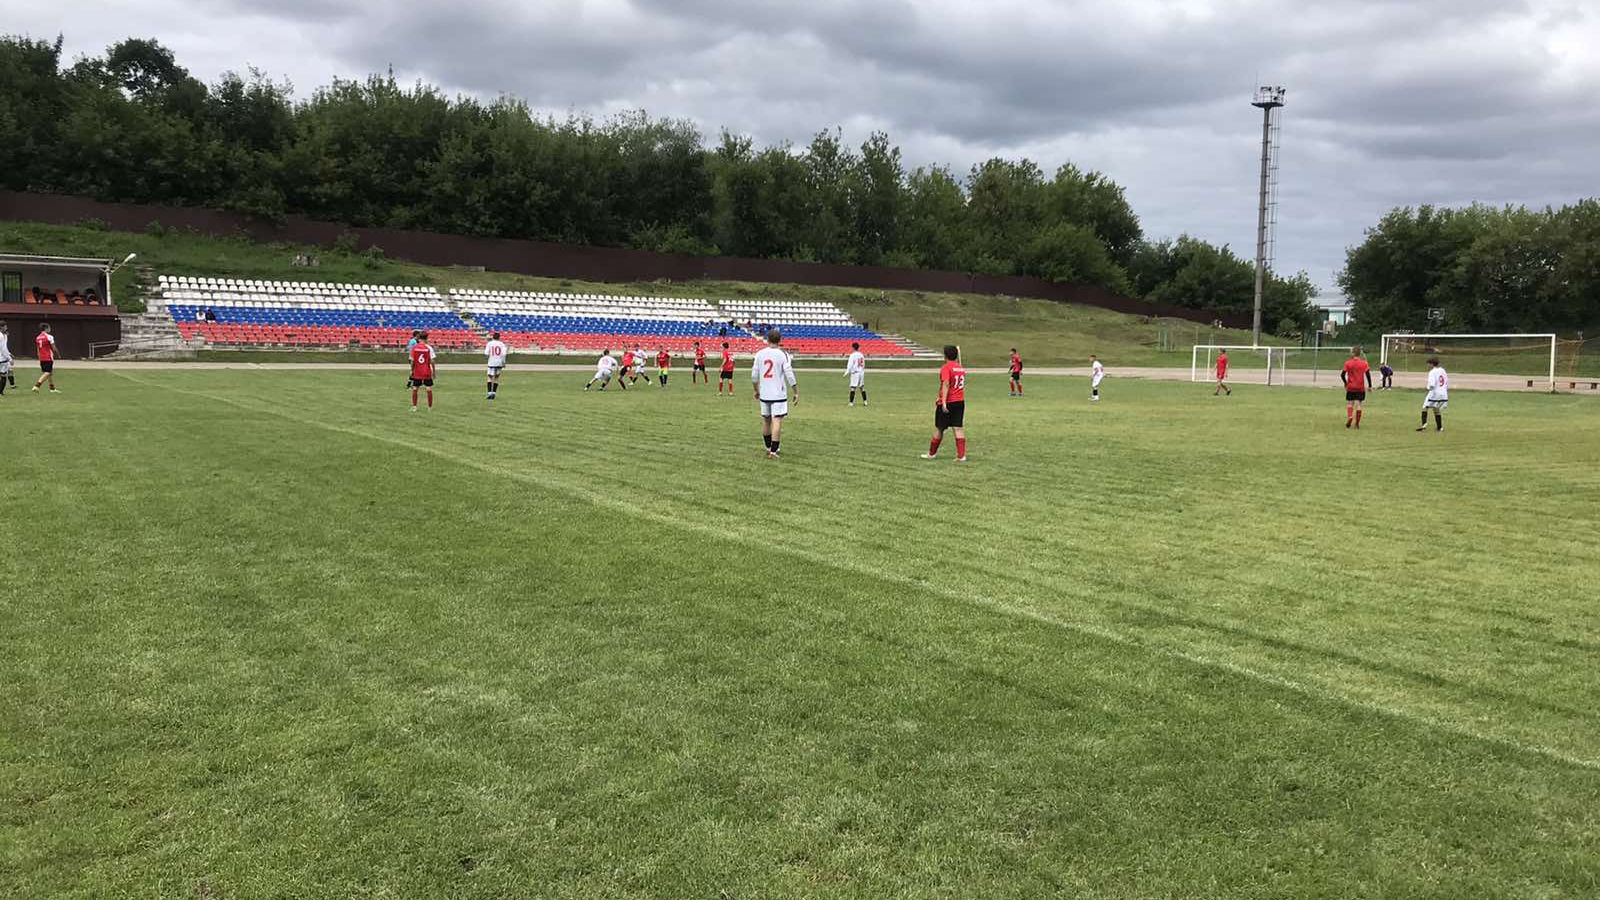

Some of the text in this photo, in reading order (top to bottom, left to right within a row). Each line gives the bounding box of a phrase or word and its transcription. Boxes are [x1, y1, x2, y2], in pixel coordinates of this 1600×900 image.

[491, 346, 502, 356] 10
[418, 353, 425, 364] 6
[763, 359, 774, 378] 2
[1439, 375, 1445, 387] 9
